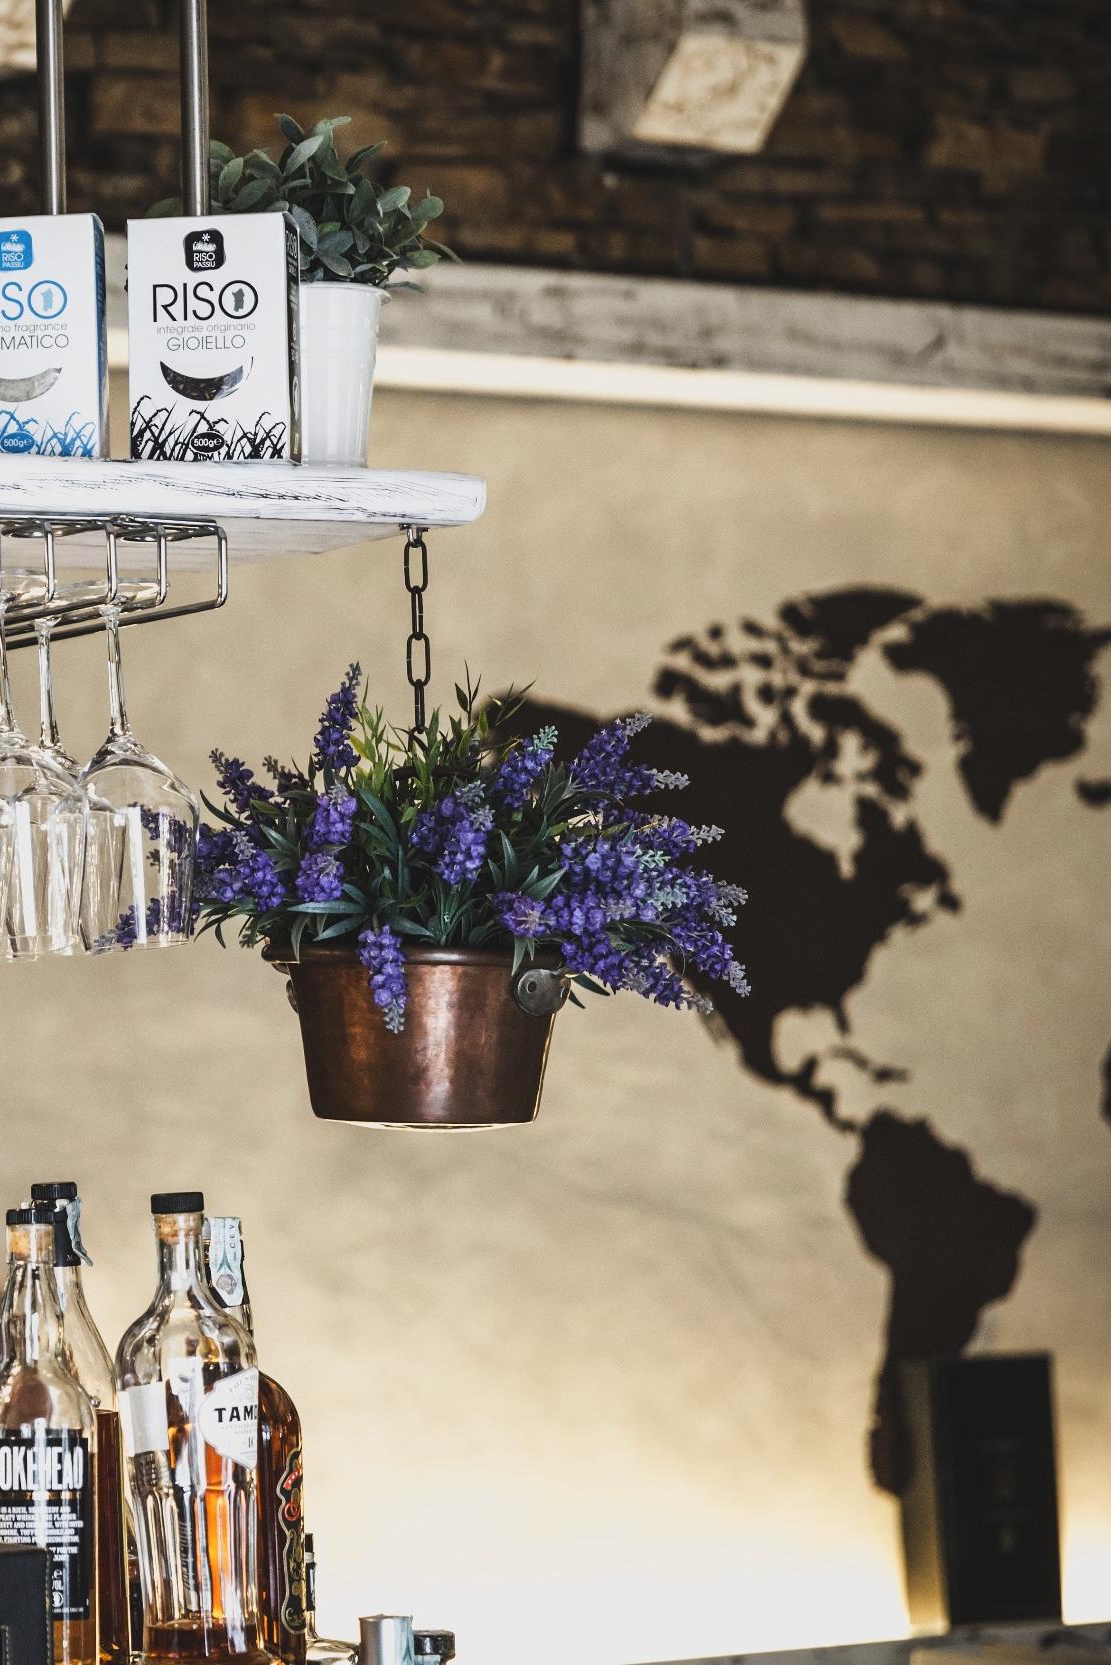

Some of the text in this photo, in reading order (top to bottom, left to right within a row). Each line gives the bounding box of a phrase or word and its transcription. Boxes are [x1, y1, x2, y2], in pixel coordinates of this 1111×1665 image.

[1, 252, 24, 262] RISO
[193, 252, 216, 262] RISO
[152, 279, 259, 323] RISO
[14, 322, 68, 333] fragrance
[156, 322, 256, 335] integrale originario
[166, 334, 246, 351] GIOIELLO
